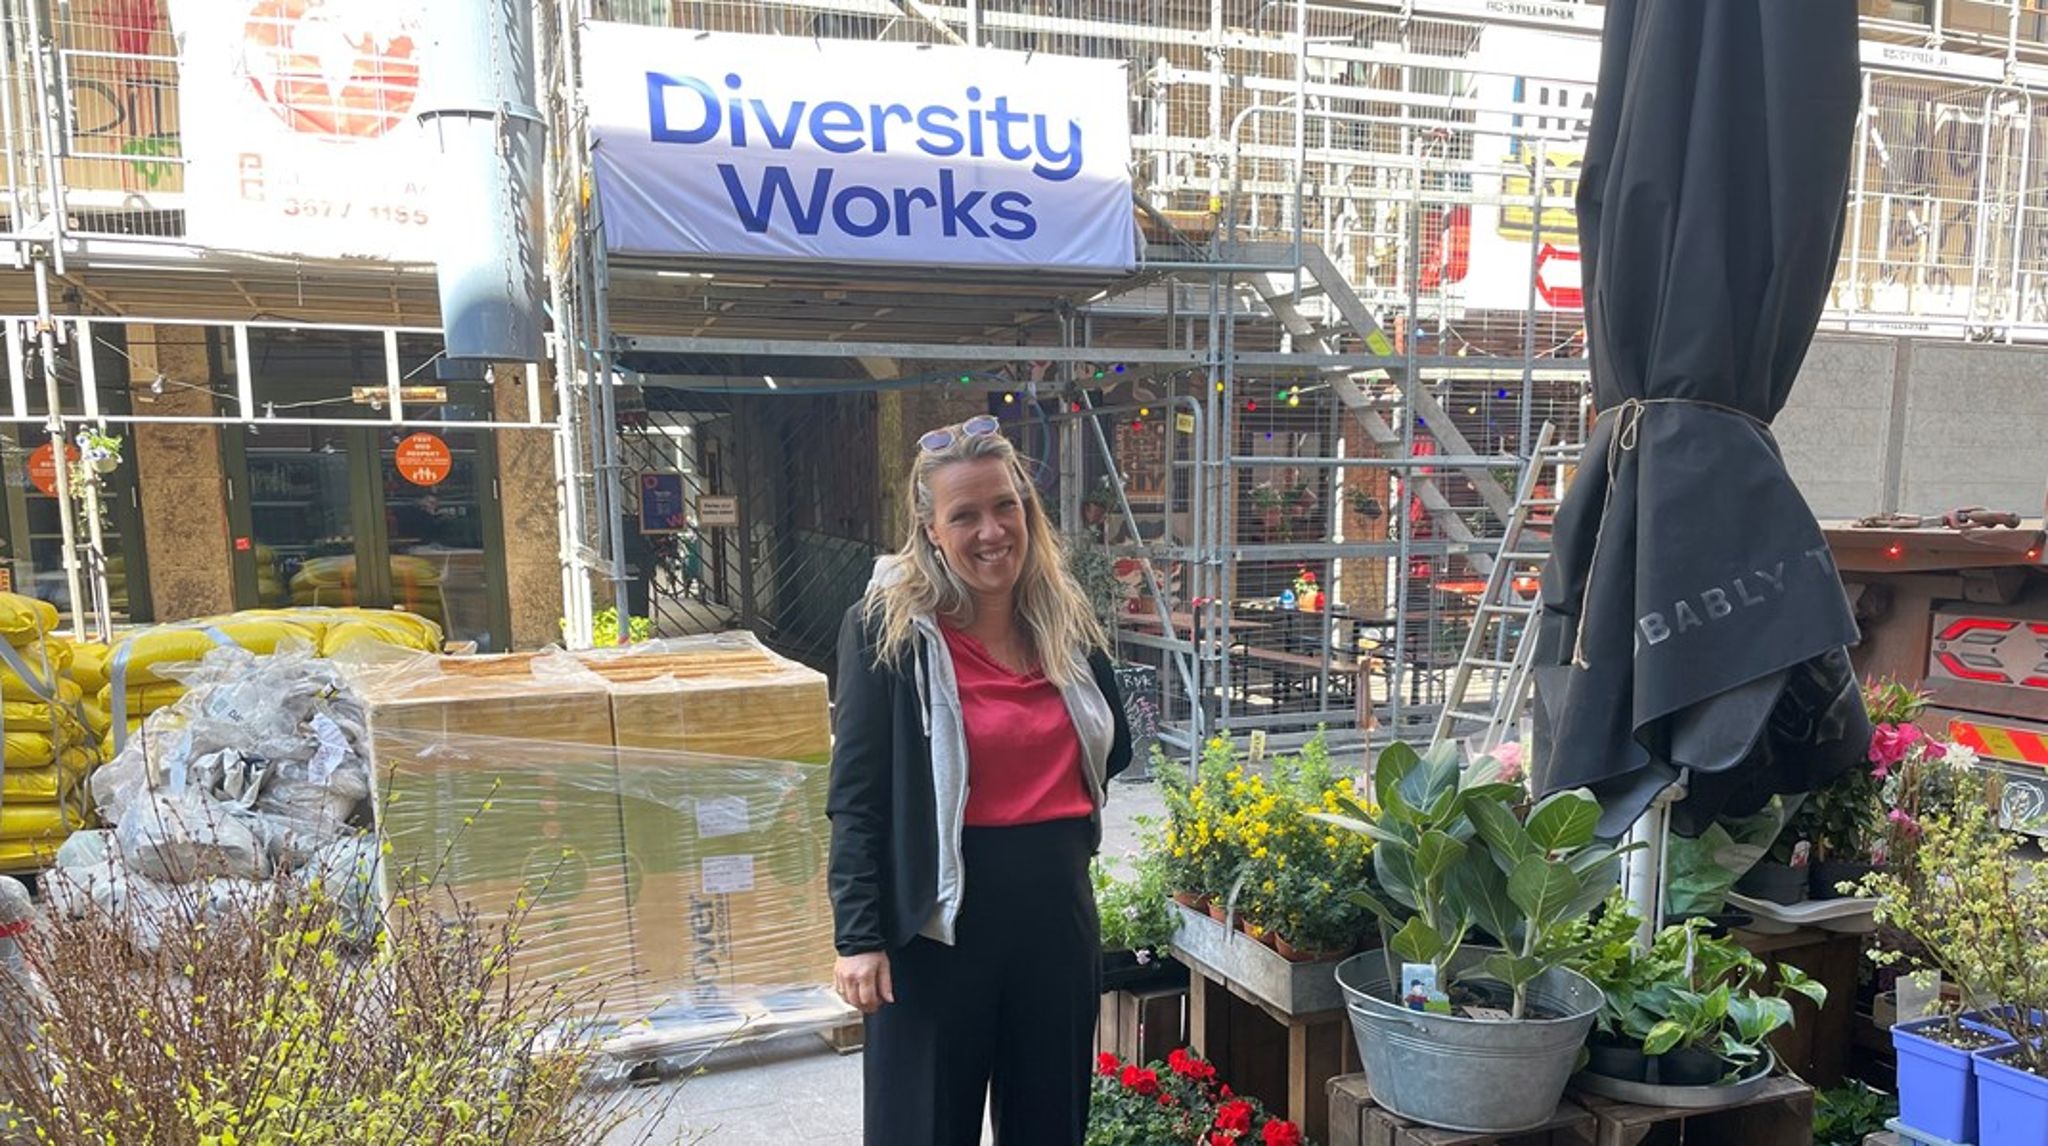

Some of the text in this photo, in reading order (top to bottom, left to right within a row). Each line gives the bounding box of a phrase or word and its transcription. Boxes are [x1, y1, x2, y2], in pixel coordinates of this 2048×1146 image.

[645, 70, 1084, 181] Diversity
[717, 163, 1038, 240] Works
[1634, 561, 1785, 657] BABLY
